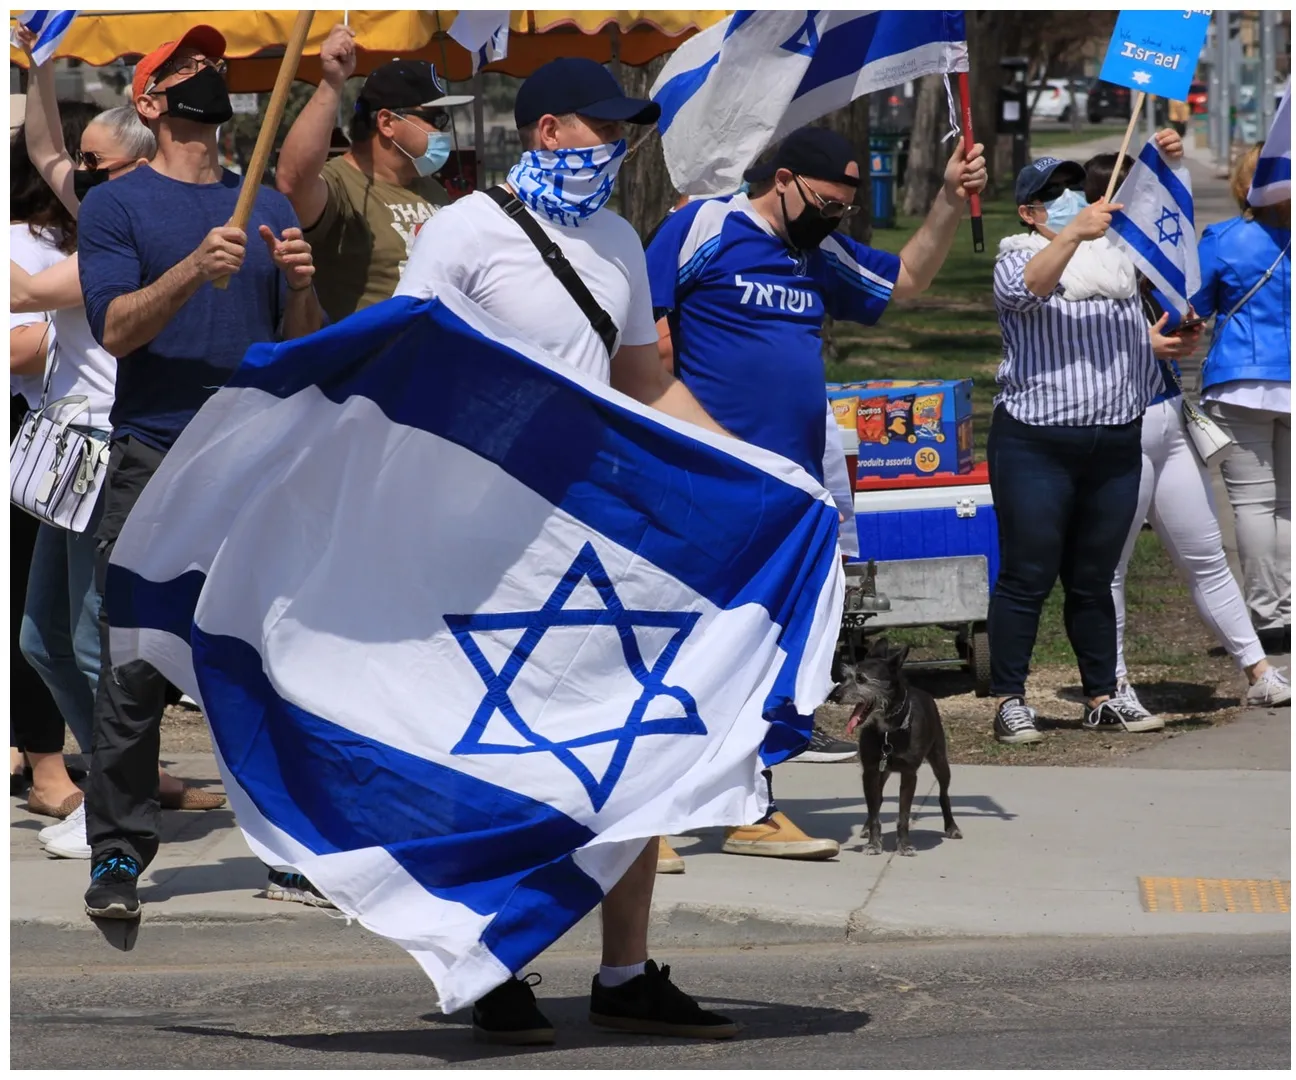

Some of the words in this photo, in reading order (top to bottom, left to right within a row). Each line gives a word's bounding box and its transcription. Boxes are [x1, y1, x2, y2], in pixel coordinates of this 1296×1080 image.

[1120, 42, 1180, 70] Israel
[384, 203, 441, 224] THAN
[735, 274, 812, 313] ישראל
[858, 407, 881, 416] Doritos
[885, 456, 912, 467] assortis
[920, 452, 936, 463] 50
